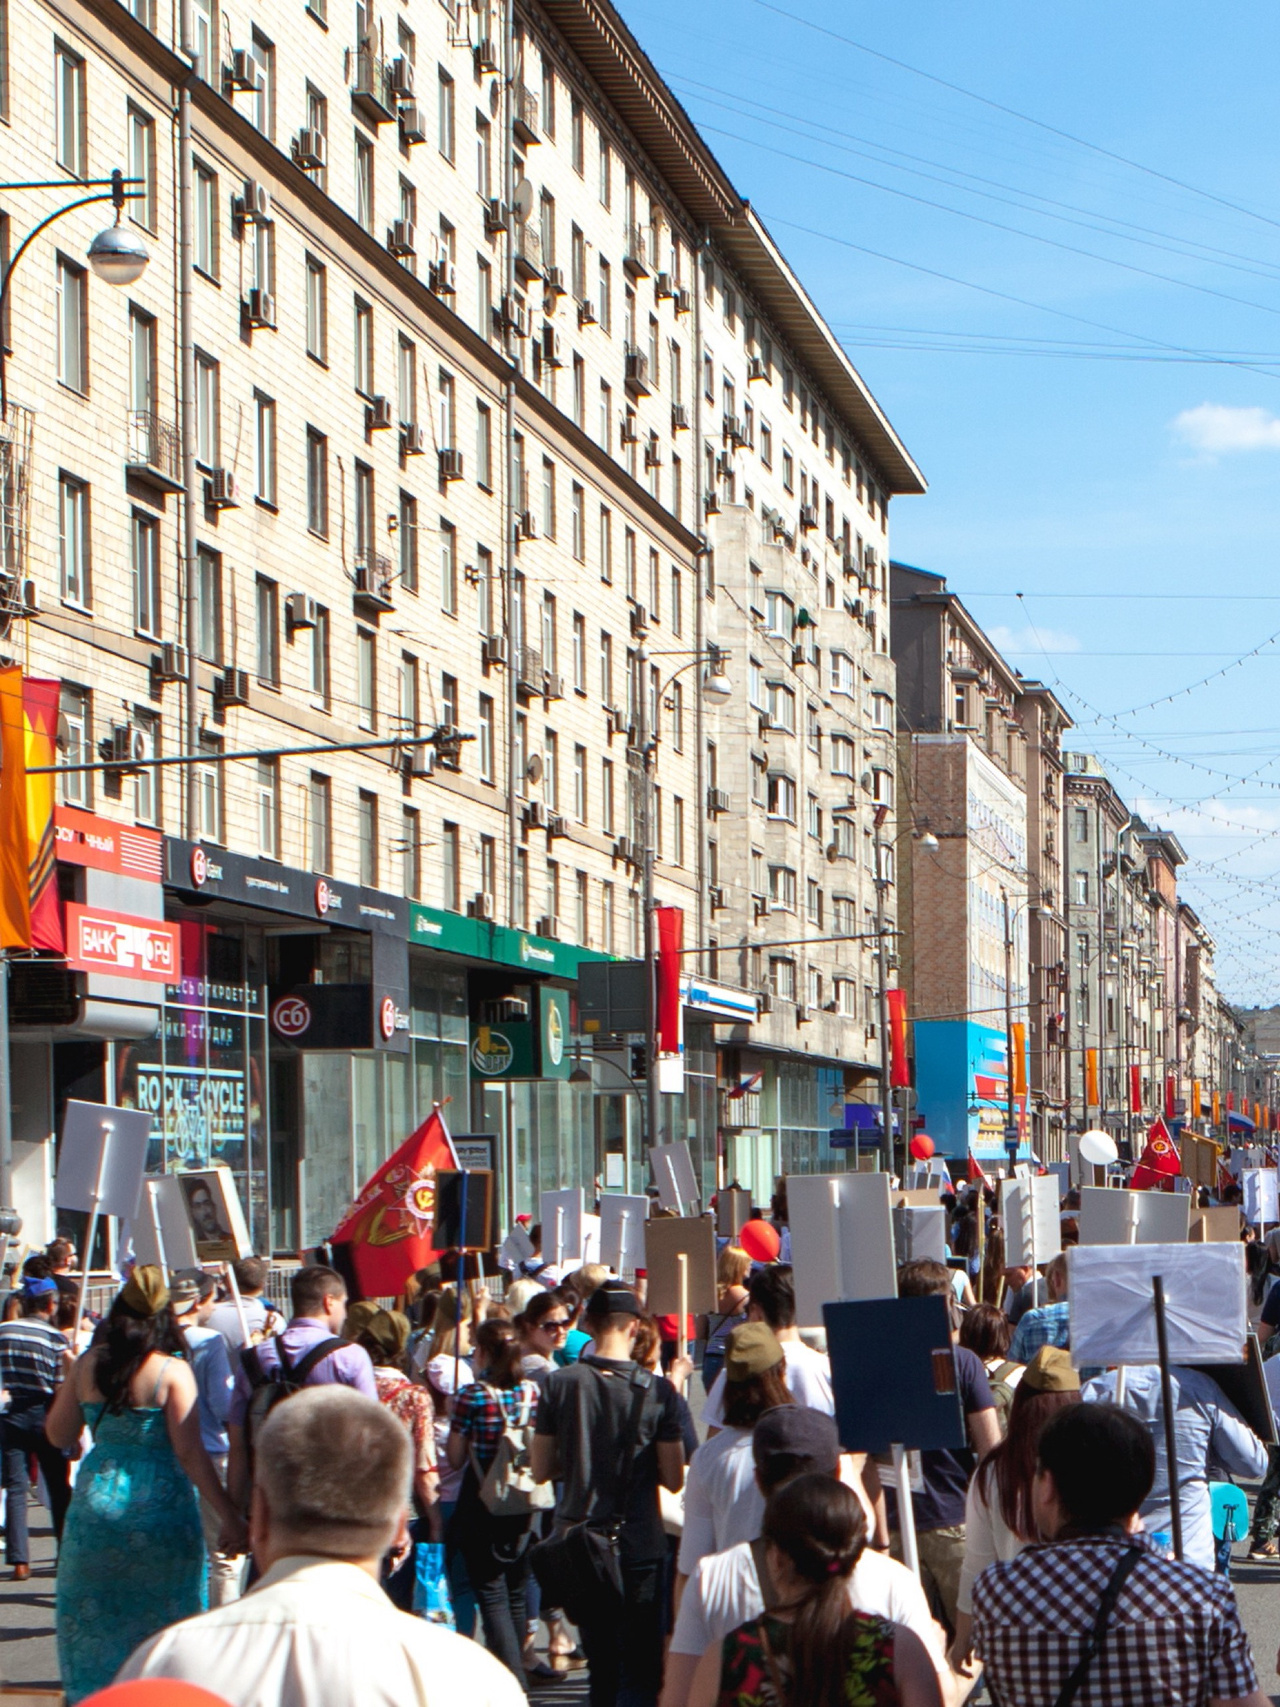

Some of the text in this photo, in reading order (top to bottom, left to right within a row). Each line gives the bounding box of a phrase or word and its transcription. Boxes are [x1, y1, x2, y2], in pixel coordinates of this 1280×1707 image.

[197, 982, 257, 1004] ОТКРОЕТСЯ
[137, 1075, 185, 1112] ROCK
[199, 1080, 245, 1114] CYCLE
